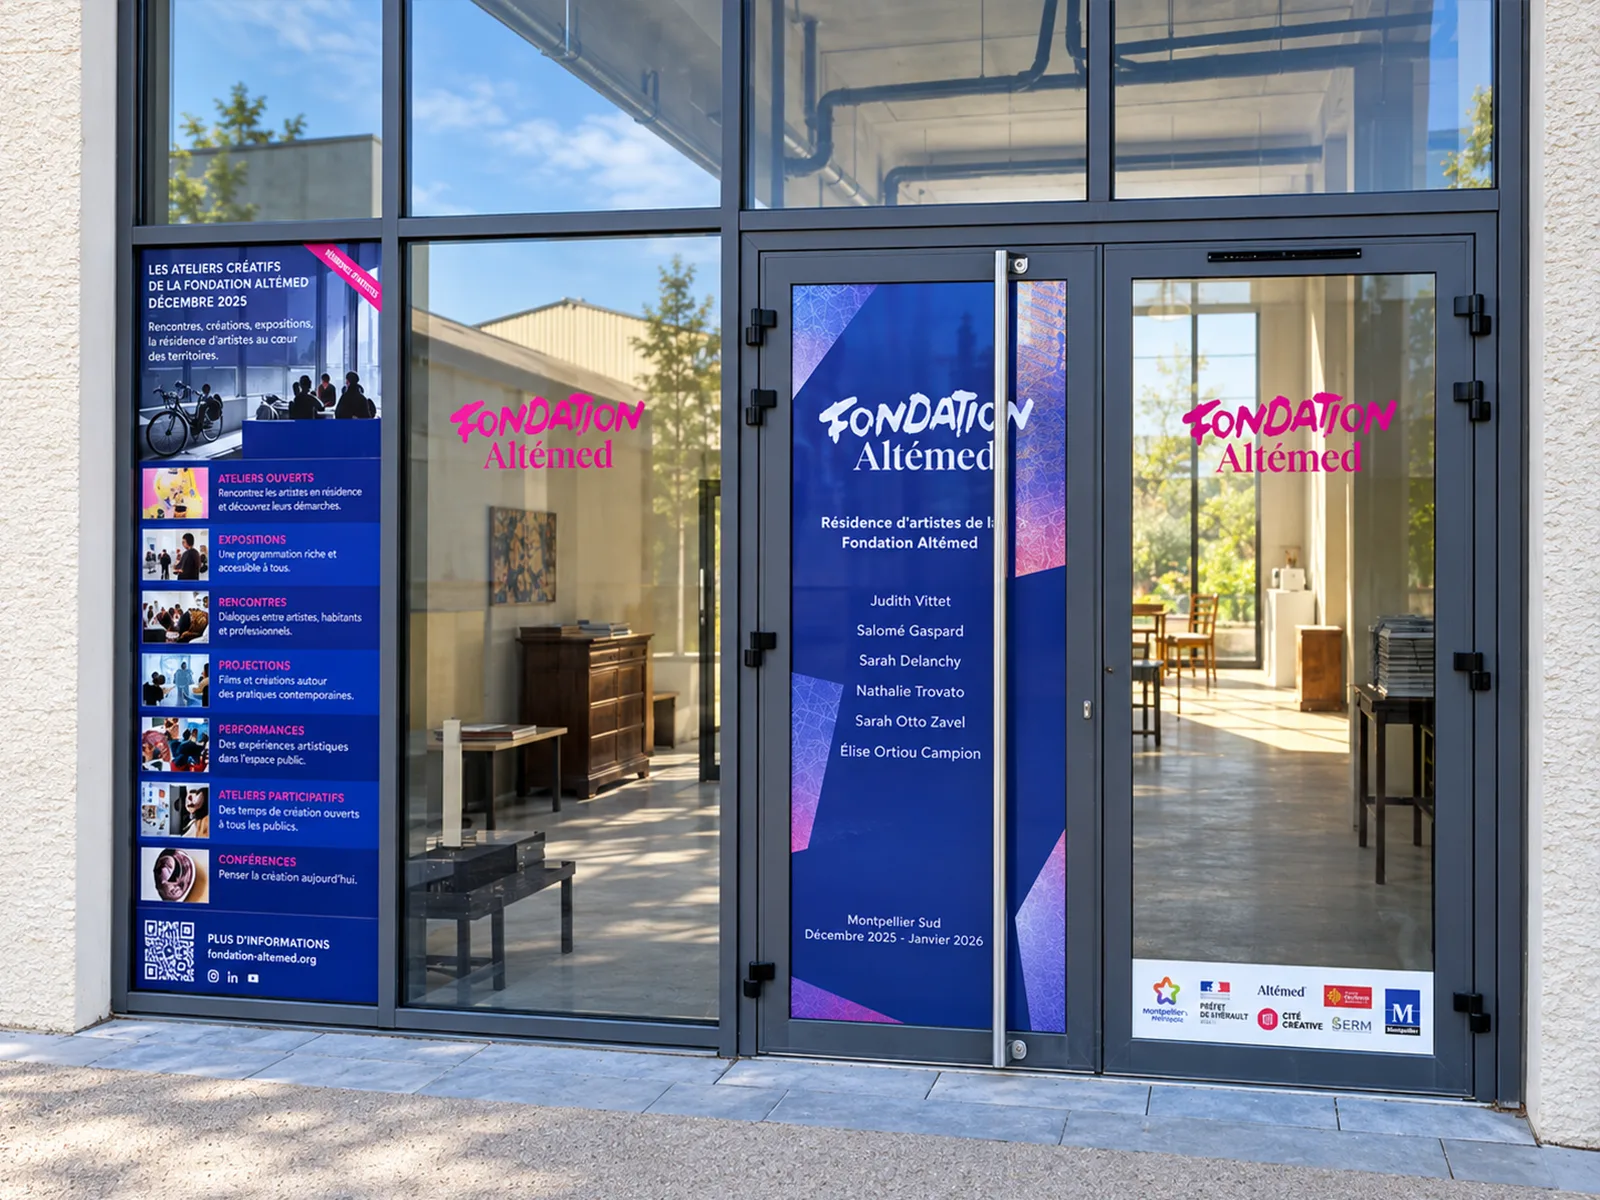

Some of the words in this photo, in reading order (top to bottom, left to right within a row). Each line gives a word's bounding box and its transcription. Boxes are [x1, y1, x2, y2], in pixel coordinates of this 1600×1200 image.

[149, 264, 168, 275] LES
[172, 263, 223, 274] ATELIERS
[226, 260, 281, 273] CRÉATIFS
[148, 280, 164, 291] DE
[167, 280, 181, 290] LA
[184, 279, 251, 290] FONDATION
[255, 275, 309, 288] ALTÉMED
[149, 295, 213, 308] DÉCEMBRE
[218, 296, 247, 306] 2025
[149, 322, 203, 331] Rencontres,
[206, 321, 252, 330] créations,
[255, 318, 313, 331] expositions,
[149, 337, 156, 346] la
[160, 336, 206, 346] résidence
[209, 334, 254, 345] d'artistes
[271, 336, 298, 344] cœur
[148, 352, 166, 361] des
[168, 350, 218, 360] territoires.
[450, 393, 645, 443] FONDATION
[819, 390, 1034, 444] FONDATION
[1182, 392, 1397, 445] FONDATION
[483, 440, 613, 469] Altémed
[853, 440, 995, 471] Altémed
[1216, 441, 1362, 473] Altémed
[218, 474, 263, 483] ATELIERS
[265, 473, 314, 483] OUVERTS
[218, 488, 264, 497] Rencontrez
[266, 488, 277, 496] les
[322, 487, 362, 496] résidence
[228, 502, 270, 511] découvrez
[272, 501, 292, 510] leurs
[294, 501, 341, 510] démarches.
[822, 516, 892, 528] Résidence
[897, 517, 961, 528] d'artistes
[966, 517, 982, 528] de
[218, 535, 286, 545] EXPOSITIONS
[843, 536, 912, 548] Fondation
[918, 536, 977, 548] Altémed
[219, 550, 235, 558] Une
[237, 550, 302, 561] programmation
[304, 550, 326, 558] riche
[328, 550, 336, 558] et
[218, 564, 261, 572] accessible
[263, 563, 268, 572] à
[270, 564, 290, 572] tous.
[219, 598, 286, 607] RENCONTRES
[871, 595, 910, 606] Judith
[915, 595, 950, 606] Vittet
[219, 612, 260, 624] Dialogues
[286, 613, 319, 622] artistes,
[322, 612, 362, 622] habitants
[230, 625, 292, 636] professionnels.
[858, 624, 905, 636] Salomé
[910, 625, 963, 639] Gaspard
[219, 660, 290, 671] PROJECTIONS
[860, 654, 896, 666] Sarah
[901, 655, 961, 670] Delanchy
[219, 675, 241, 684] Films
[255, 676, 295, 685] créations
[218, 690, 234, 698] des
[236, 690, 277, 700] pratiques
[279, 691, 354, 700] contemporaines.
[857, 685, 911, 696] Nathalie
[915, 686, 964, 698] Trovato
[856, 715, 892, 726] Sarah
[896, 716, 926, 727] Otto
[931, 716, 965, 728] Zavel
[219, 725, 304, 736] PERFORMANCES
[219, 739, 237, 749] Des
[239, 740, 295, 752] expériences
[298, 742, 348, 753] artistiques
[841, 743, 870, 757] Élise
[874, 746, 916, 758] Ortiou
[922, 746, 980, 761] Campion
[218, 754, 238, 762] dans
[241, 754, 275, 765] l'espace
[277, 756, 306, 766] public.
[218, 790, 266, 801] ATELIERS
[268, 792, 344, 803] PARTICIPATIFS
[219, 805, 237, 815] Des
[238, 806, 267, 818] temps
[269, 807, 281, 816] de
[283, 807, 321, 817] création
[324, 810, 360, 818] ouverts
[218, 820, 224, 828] à
[226, 821, 246, 830] tous
[248, 820, 260, 830] les
[263, 821, 298, 832] publics.
[218, 853, 296, 867] CONFÉRENCES
[219, 869, 249, 879] Penser
[252, 871, 259, 880] la
[262, 872, 299, 882] création
[302, 874, 357, 884] aujourd'hui.
[848, 915, 915, 928] Montpellier
[919, 917, 940, 928] Sud
[208, 934, 233, 944] PLUS
[237, 936, 331, 949] D'INFORMATIONS
[806, 929, 865, 942] Décembre
[868, 931, 897, 942] 2025
[908, 932, 951, 944] Janvier
[954, 935, 984, 946] 2026
[208, 949, 317, 966] fondation-altemed.org
[1257, 984, 1305, 998] Altémed
[1282, 1011, 1301, 1020] CITÉ
[1392, 1003, 1414, 1023] M
[1332, 1016, 1372, 1031] SERM
